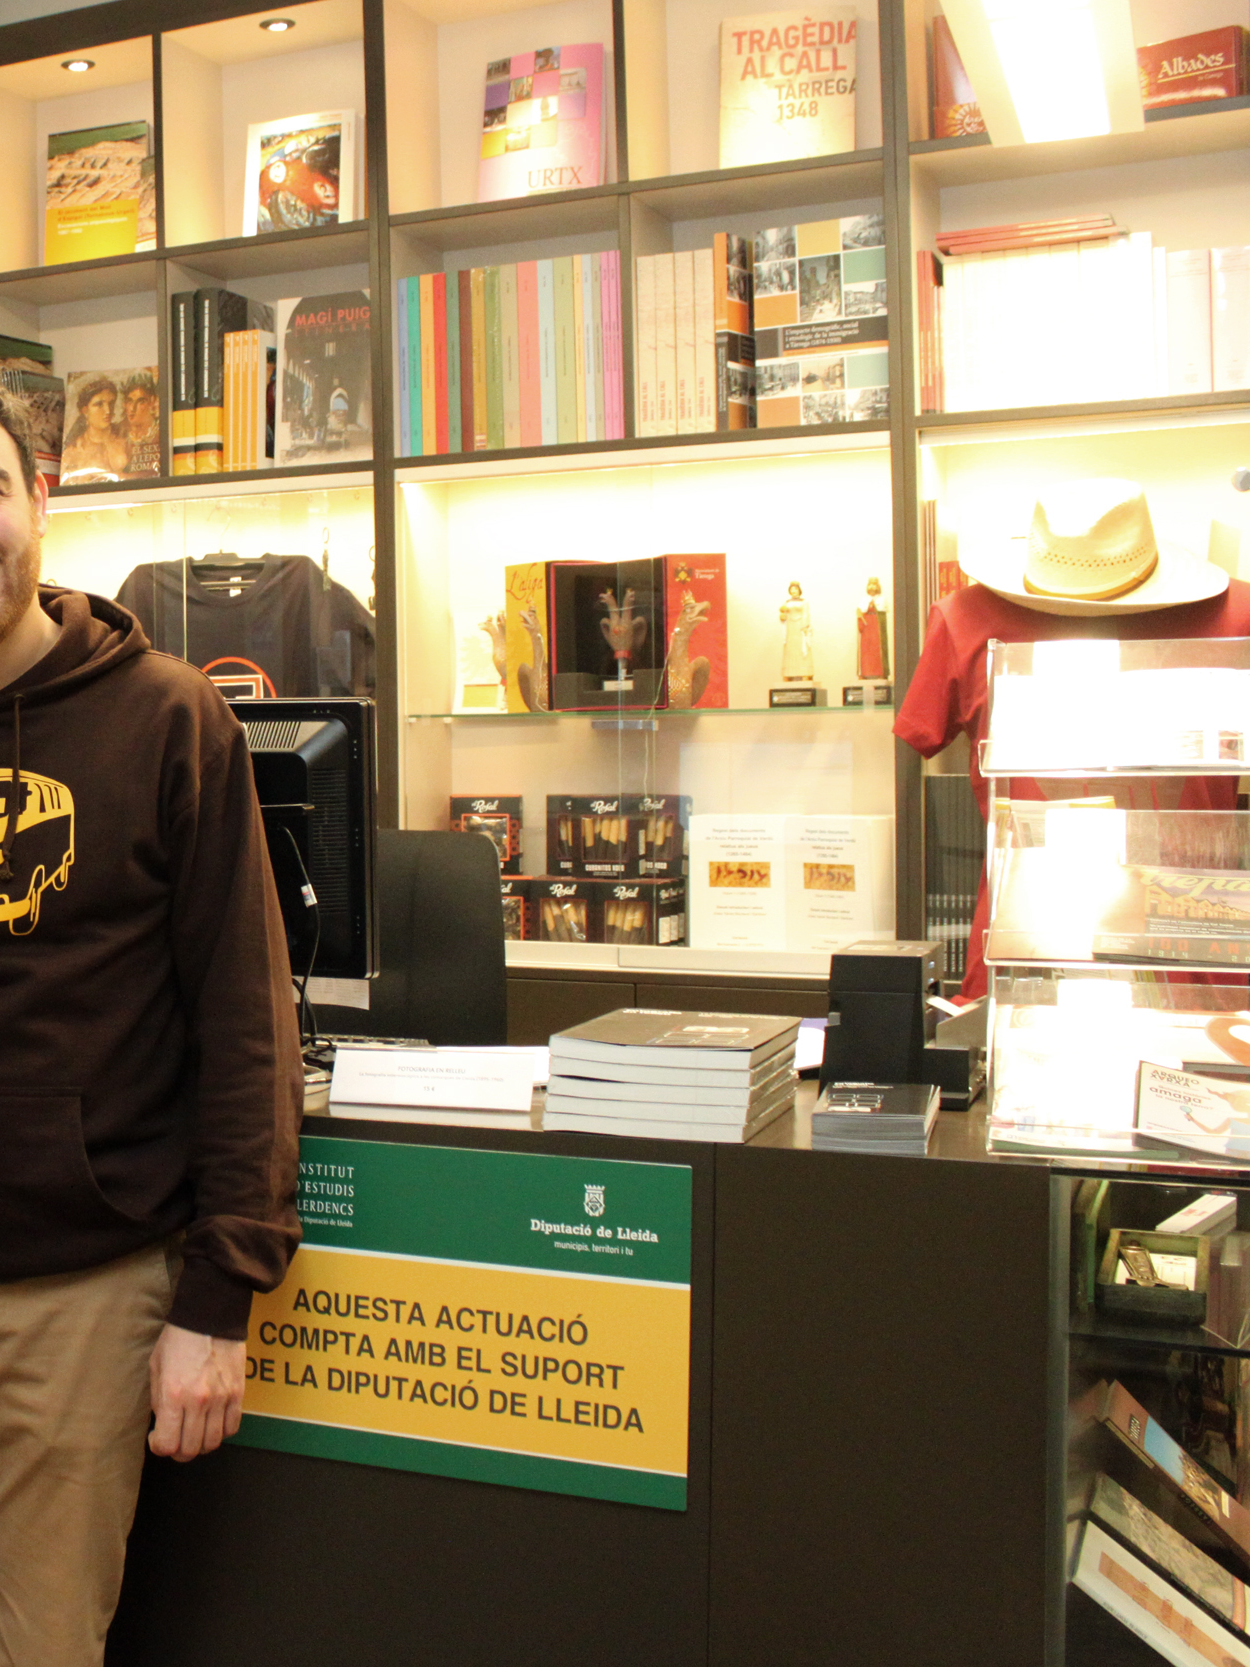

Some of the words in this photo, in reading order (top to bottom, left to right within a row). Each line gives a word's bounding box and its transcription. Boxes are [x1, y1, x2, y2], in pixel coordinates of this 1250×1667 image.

[732, 16, 857, 55] TRAGÈDIA
[740, 54, 775, 81] AL
[779, 47, 847, 76] CALL
[1158, 52, 1224, 79] Albades
[774, 77, 857, 101] TÀRREGA
[777, 100, 818, 120] 1348
[528, 166, 583, 189] URTX
[295, 307, 332, 326] MAGÍ
[337, 306, 371, 321] PUIG
[1209, 941, 1250, 955] AN
[1152, 1069, 1200, 1085] ARQUEO
[1149, 1087, 1203, 1104] amaga
[299, 1162, 355, 1179] NSTITUT
[297, 1199, 354, 1216] LERDENCS
[530, 1218, 593, 1235] Diputació
[596, 1225, 613, 1238] de
[617, 1227, 659, 1243] Lleida
[554, 1241, 590, 1252] municipis,
[592, 1243, 620, 1254] territori
[621, 1246, 624, 1254] i
[625, 1246, 634, 1255] tu
[293, 1287, 426, 1328] AQUESTA
[435, 1304, 589, 1346] ACTUACIÓ
[259, 1320, 375, 1359] COMPTA
[385, 1337, 447, 1368] AMB
[457, 1345, 492, 1374] EL
[500, 1351, 625, 1391] SUPORT
[284, 1361, 319, 1389] LA
[327, 1368, 479, 1411] DIPUTACIÓ
[489, 1389, 527, 1419] DE
[537, 1395, 645, 1434] LLEIDA
